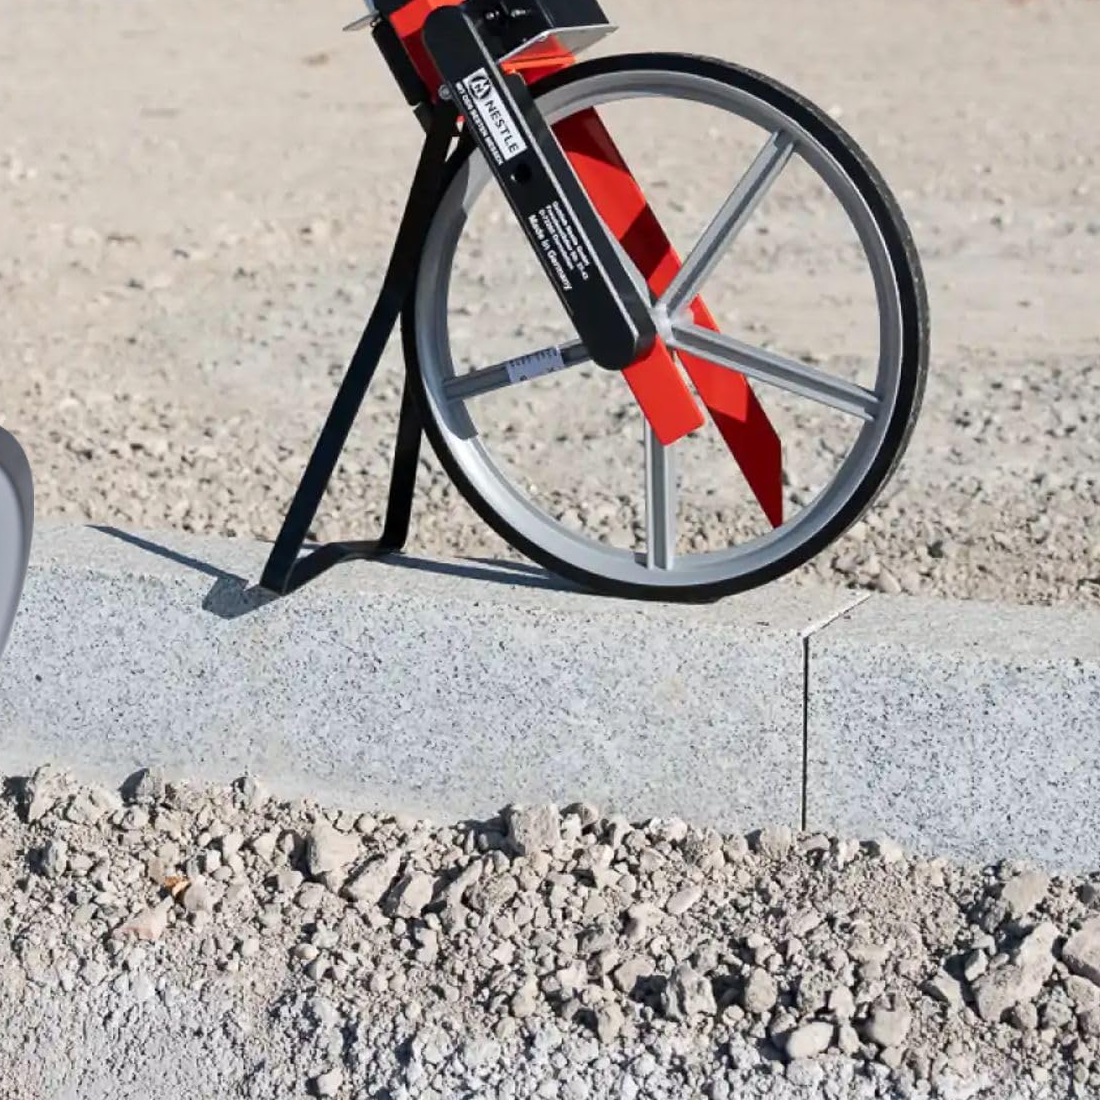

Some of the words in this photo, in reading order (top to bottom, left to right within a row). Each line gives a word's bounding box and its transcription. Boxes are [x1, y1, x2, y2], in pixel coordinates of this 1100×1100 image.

[484, 99, 518, 152] NESTLE
[528, 214, 544, 239] Made
[541, 238, 550, 250] in
[547, 249, 572, 290] Germany
